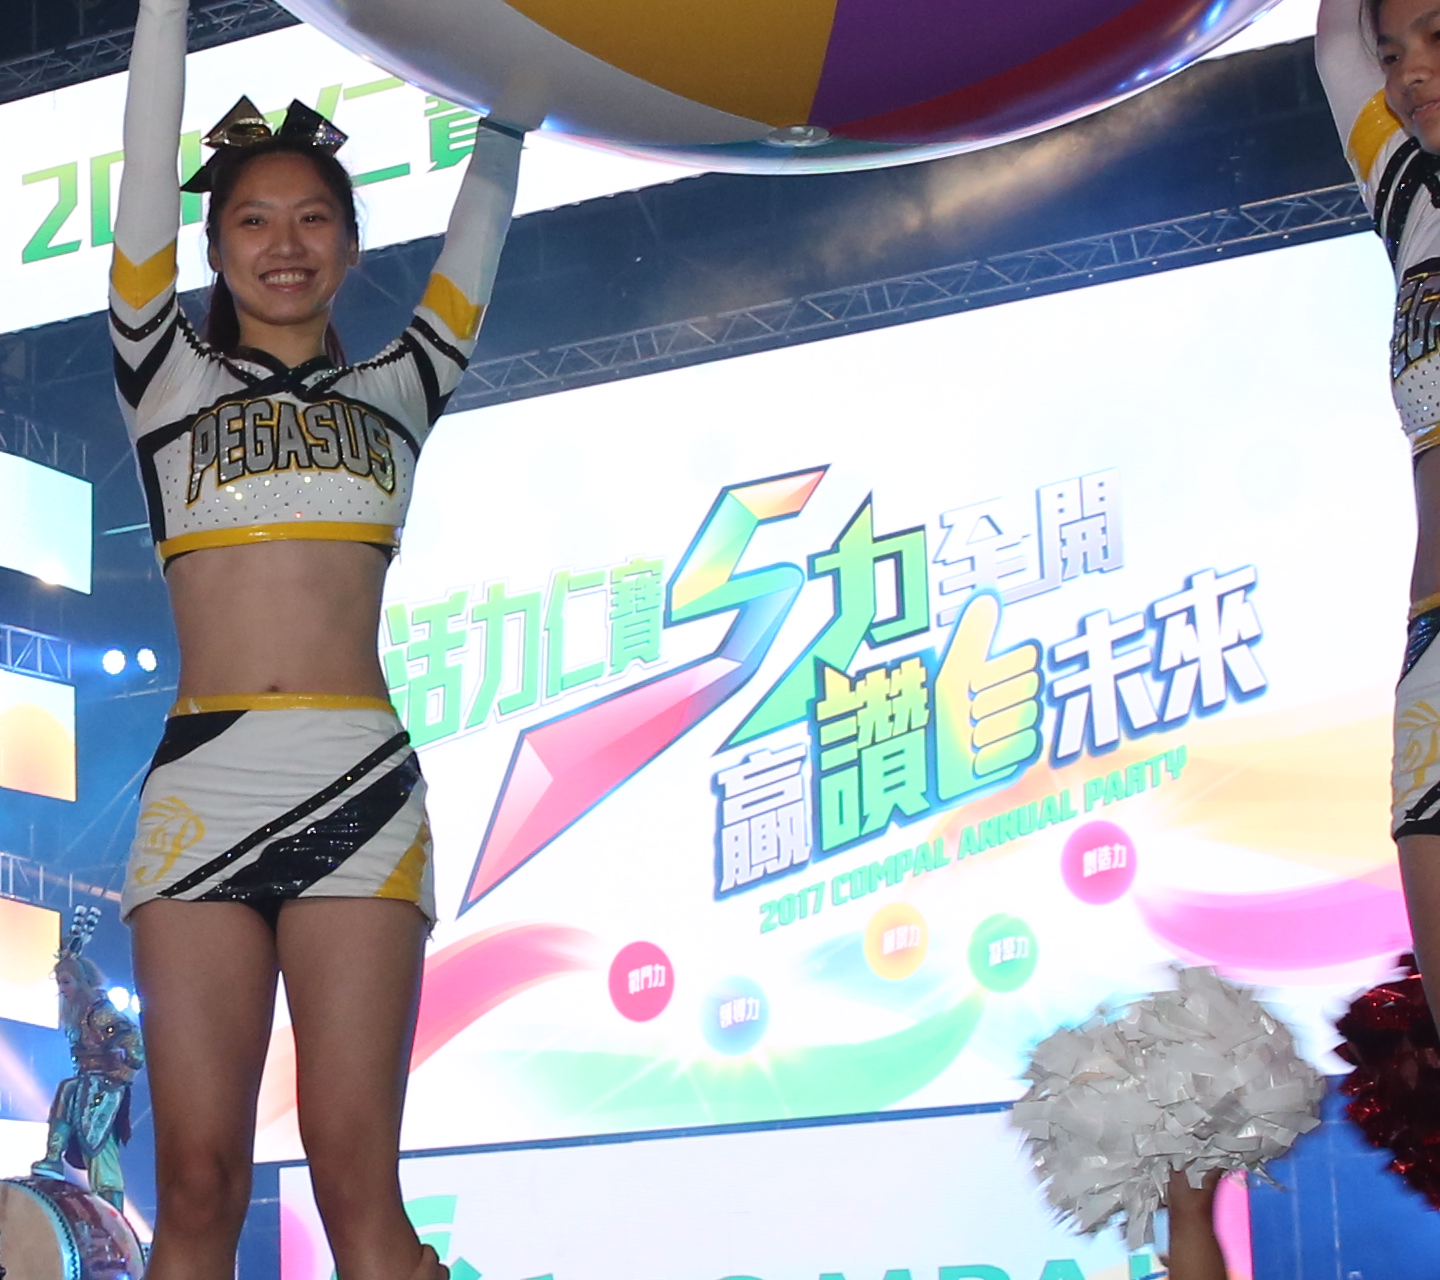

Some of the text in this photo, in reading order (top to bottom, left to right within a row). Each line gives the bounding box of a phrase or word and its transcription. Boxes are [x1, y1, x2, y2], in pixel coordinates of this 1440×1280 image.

[185, 400, 396, 508] PEGASUS
[759, 745, 1187, 934] 2017 COMPAL ANNUAL PARTY
